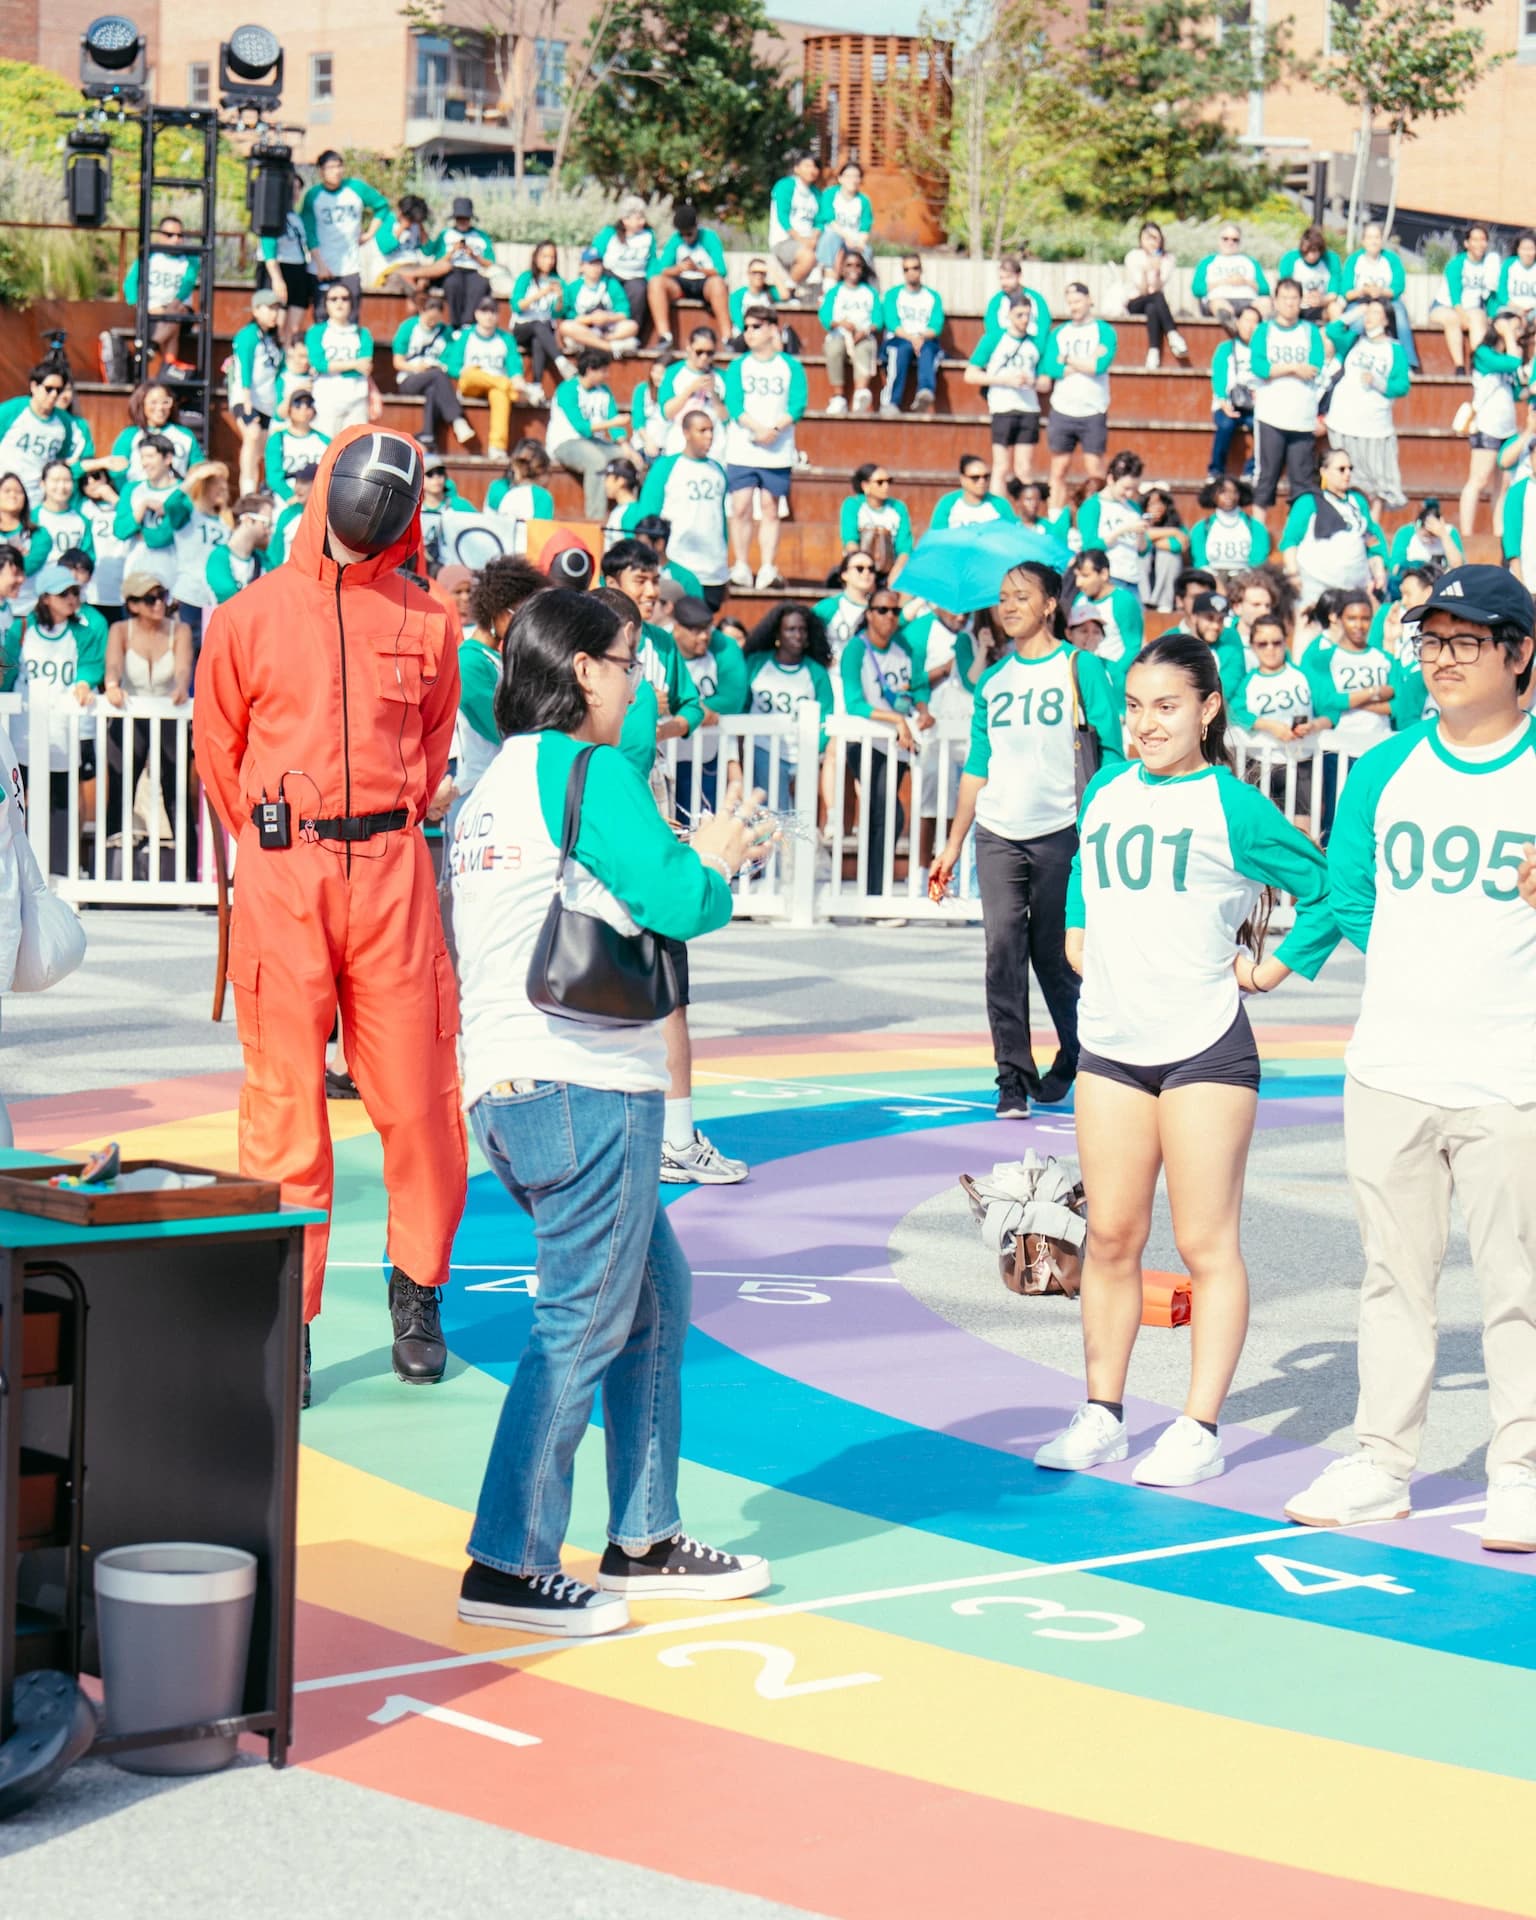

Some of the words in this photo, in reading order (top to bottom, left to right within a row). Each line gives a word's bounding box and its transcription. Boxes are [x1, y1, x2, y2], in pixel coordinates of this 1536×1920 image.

[743, 375, 784, 396] 333
[991, 687, 1064, 728] 218
[1086, 822, 1194, 892] 101
[1384, 820, 1536, 902] 095
[737, 1280, 832, 1305] 5
[1254, 1554, 1416, 1596] 4
[950, 1595, 1146, 1642] 3
[656, 1640, 884, 1700] 2
[367, 1693, 543, 1748] 1
